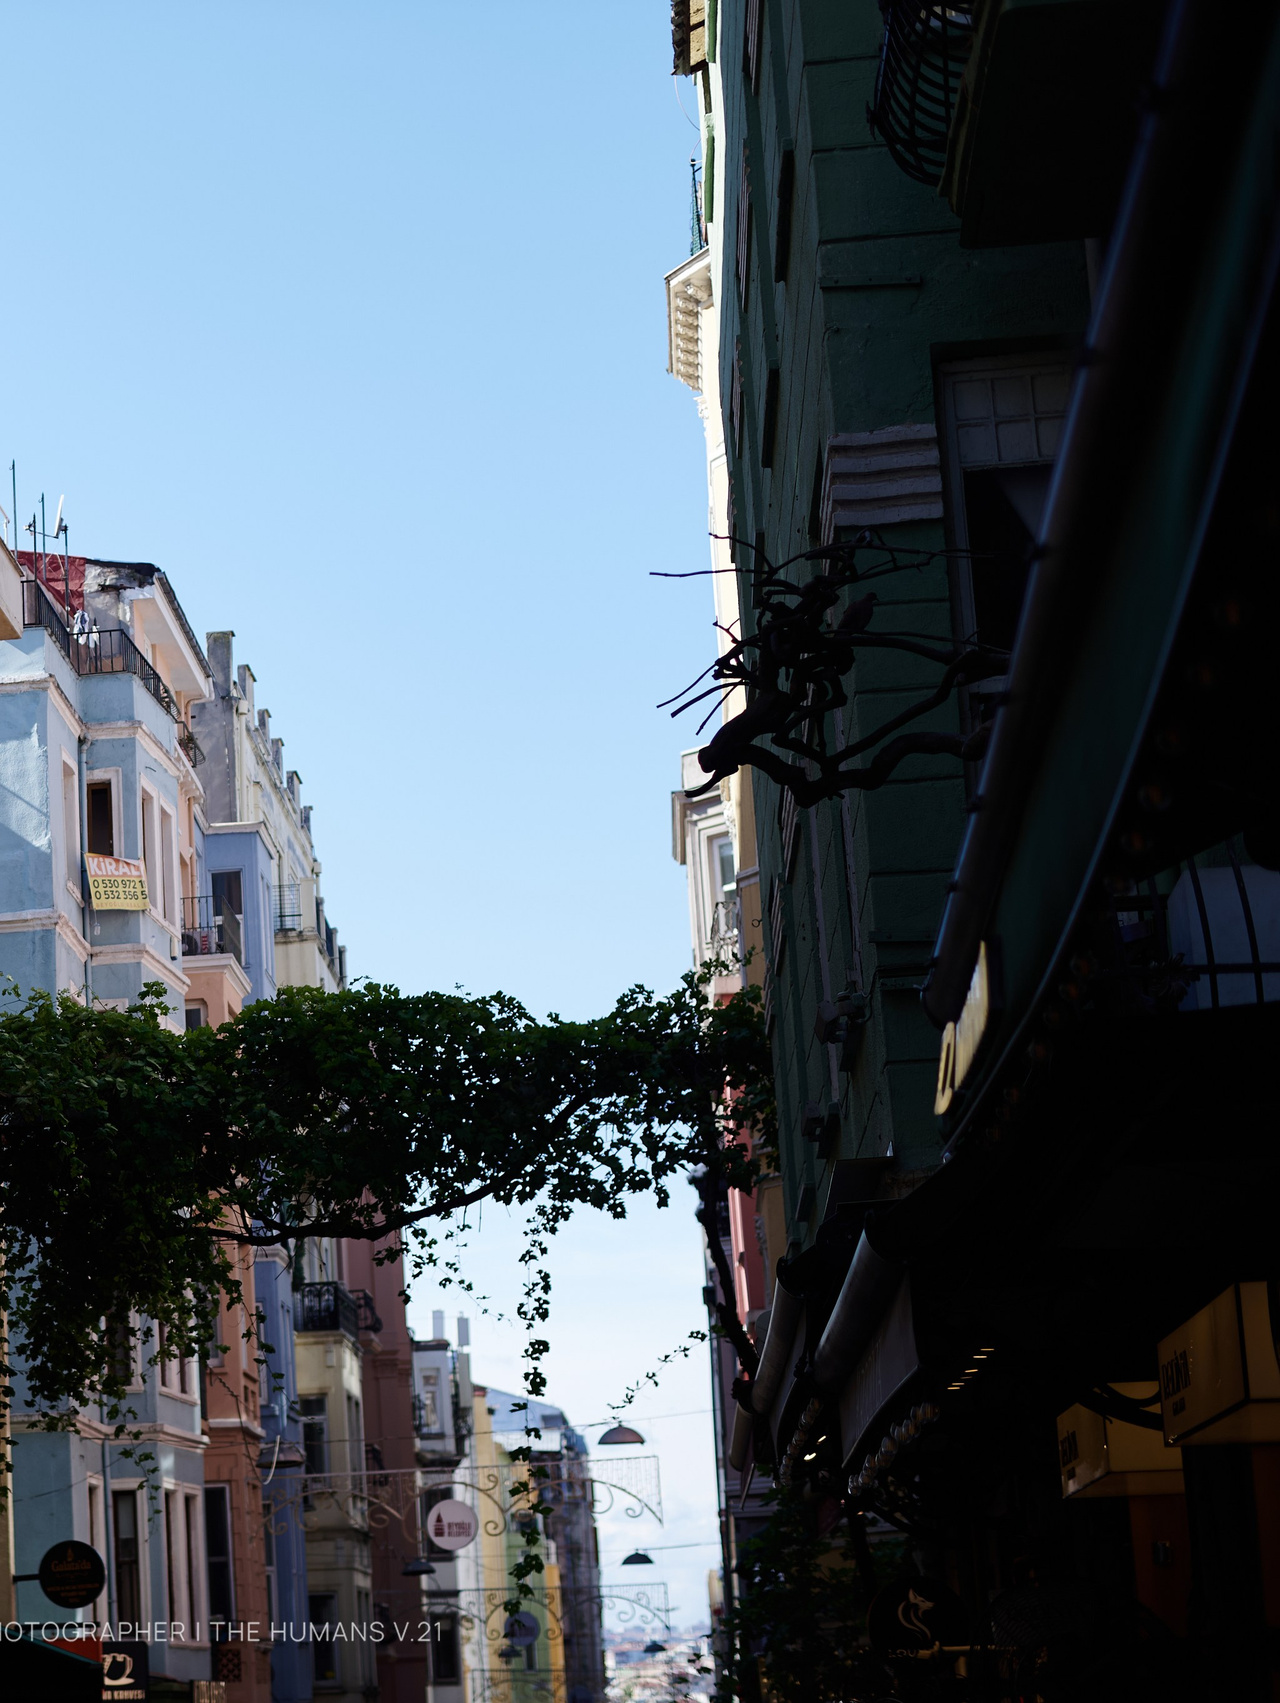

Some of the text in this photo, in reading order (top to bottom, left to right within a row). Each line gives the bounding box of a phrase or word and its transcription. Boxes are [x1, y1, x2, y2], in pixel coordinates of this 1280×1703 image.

[93, 879, 100, 889] 0
[102, 879, 120, 889] 530
[121, 879, 137, 889] 972
[95, 890, 102, 900] 0
[104, 890, 122, 900] 532
[122, 890, 139, 900] 356
